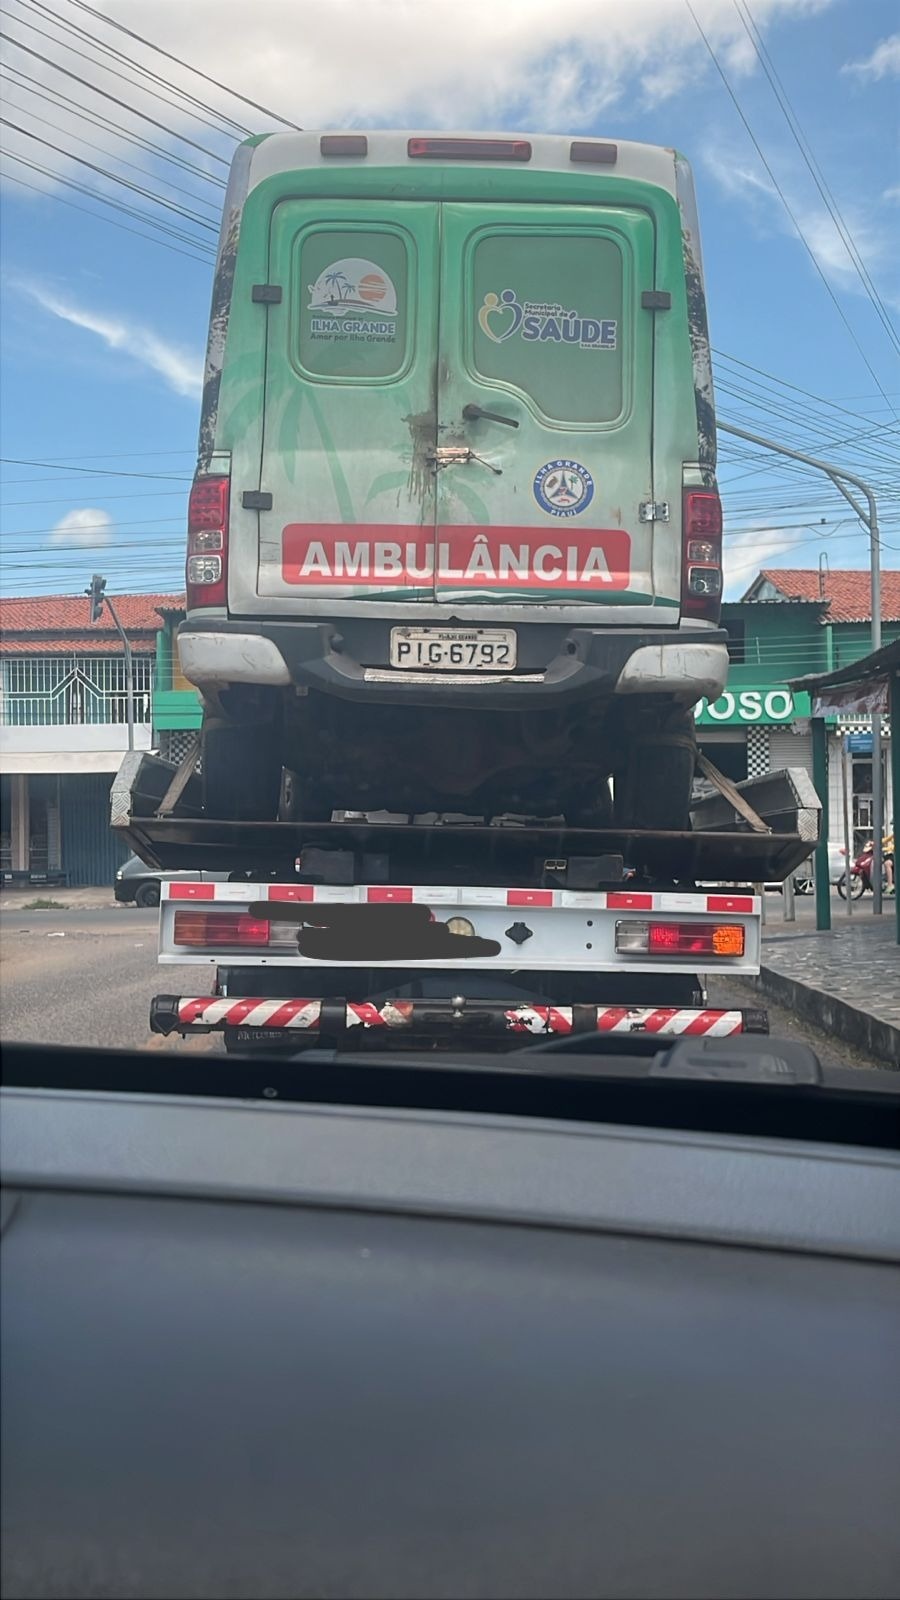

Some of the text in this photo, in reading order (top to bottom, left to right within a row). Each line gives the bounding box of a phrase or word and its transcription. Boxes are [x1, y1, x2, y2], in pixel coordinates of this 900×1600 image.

[525, 303, 561, 311] Secretaria
[311, 319, 396, 334] ILHA GRANDE
[522, 311, 616, 344] SAÚDE
[366, 335, 396, 343] Grande
[535, 461, 592, 486] ILHA GRANDE
[299, 534, 613, 582] AMBULÂNCIA
